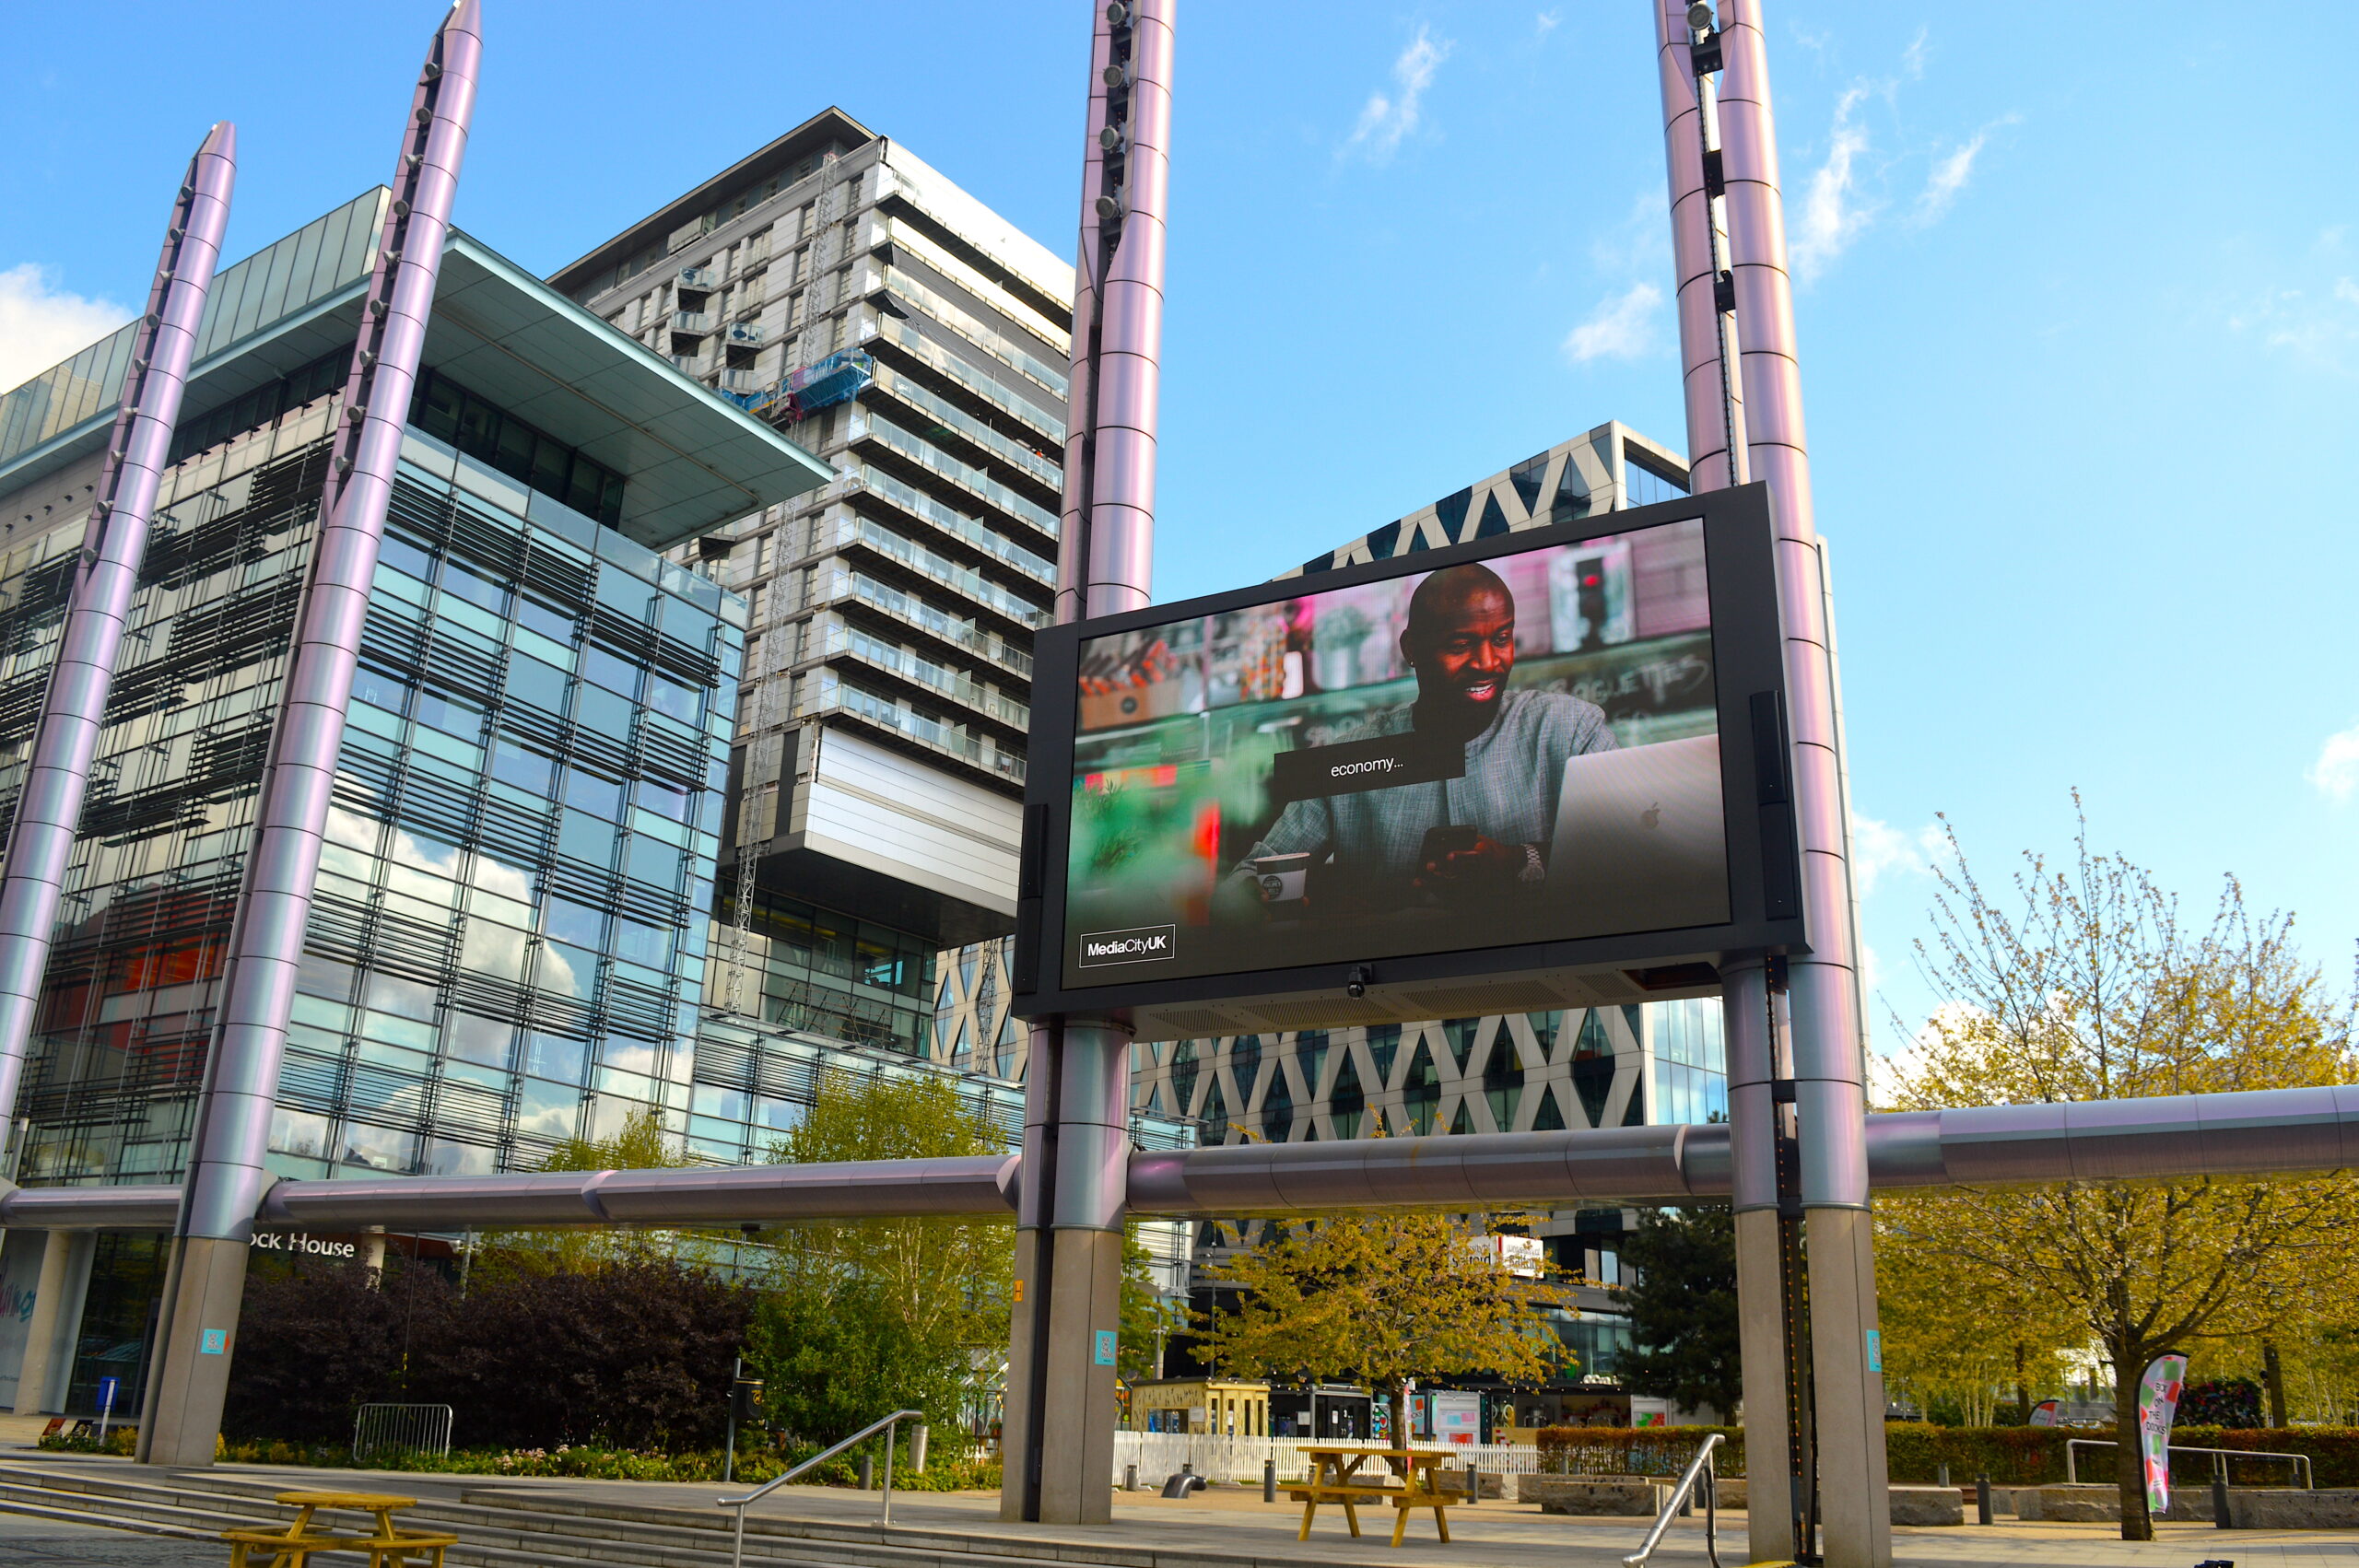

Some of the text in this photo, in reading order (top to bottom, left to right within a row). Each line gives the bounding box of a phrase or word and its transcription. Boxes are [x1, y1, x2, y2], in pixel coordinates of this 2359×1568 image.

[1331, 757, 1403, 778] economy...
[1087, 935, 1167, 957] MediaCityUK
[288, 1233, 355, 1258] House
[2154, 1395, 2165, 1408] ON
[2148, 1410, 2161, 1420] THE
